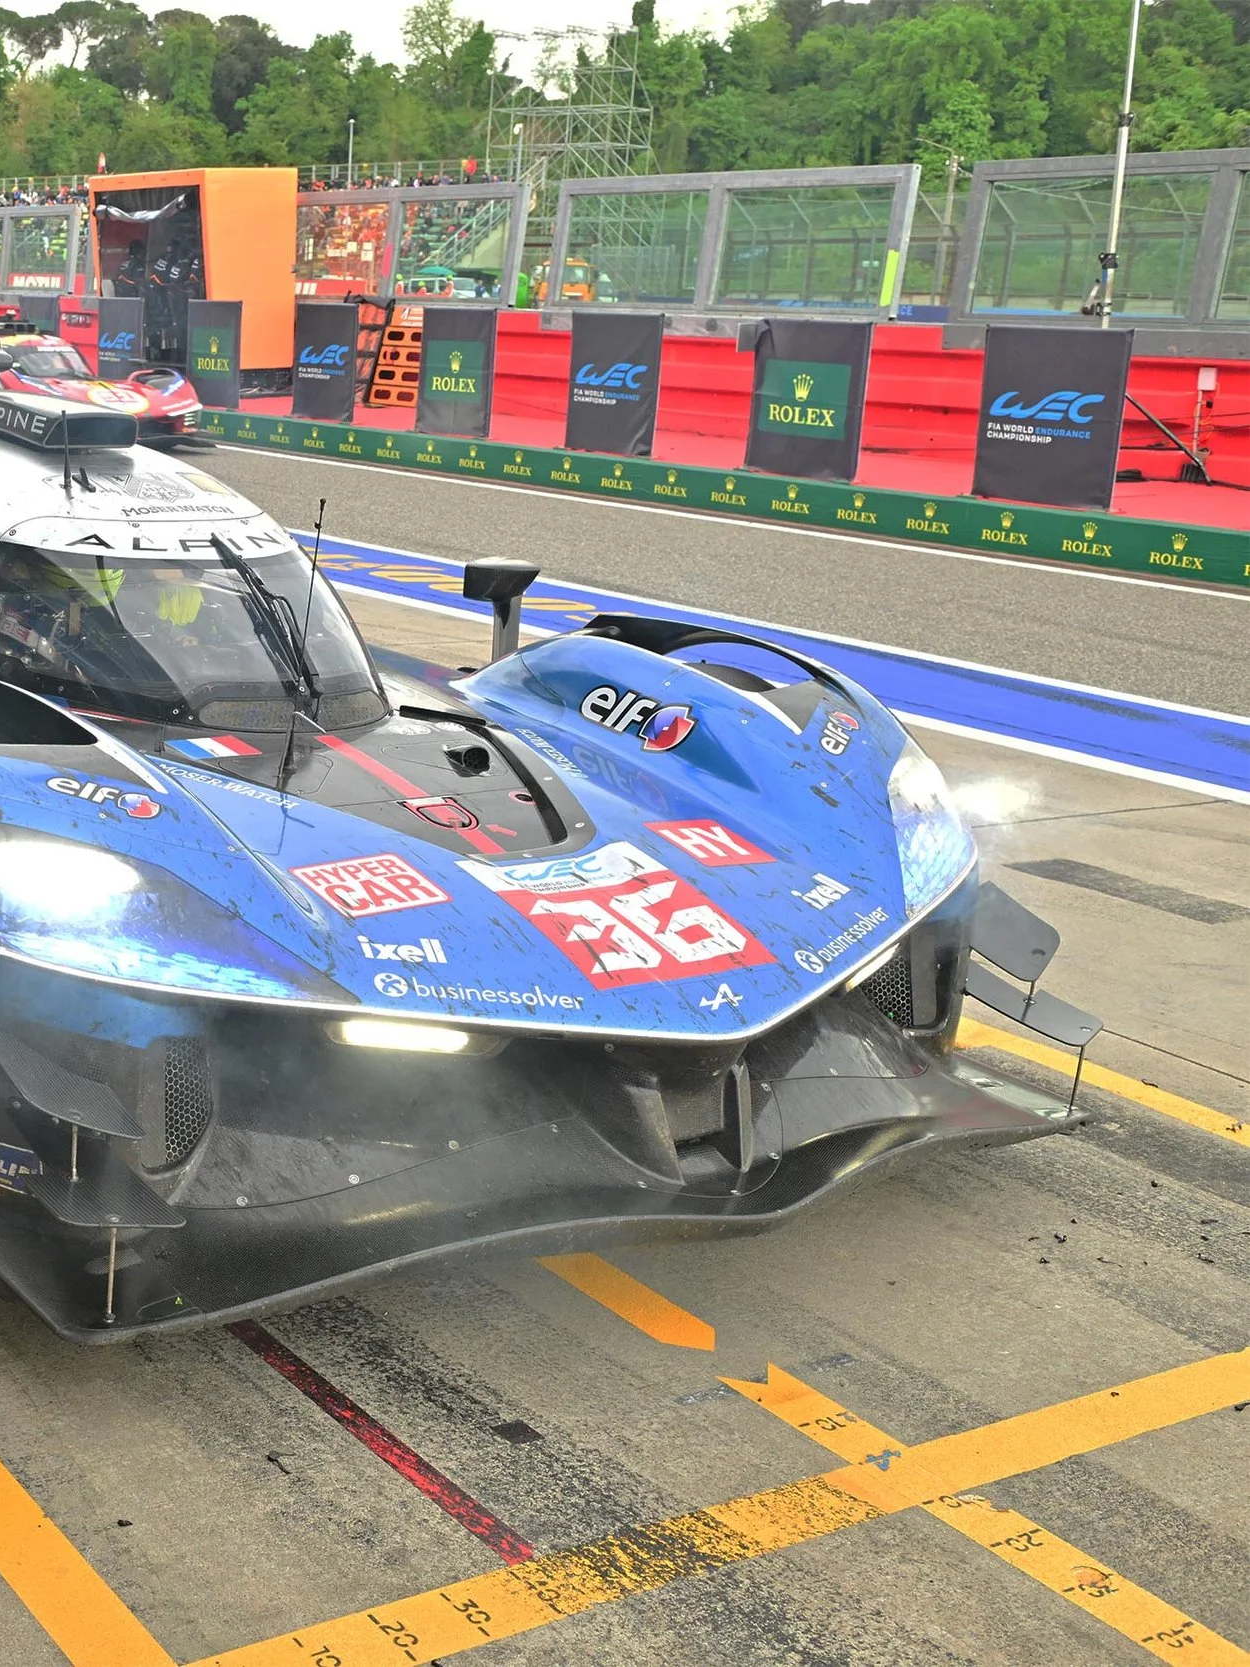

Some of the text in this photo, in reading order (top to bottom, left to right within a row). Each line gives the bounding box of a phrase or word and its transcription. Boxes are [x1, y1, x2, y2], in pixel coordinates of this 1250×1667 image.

[99, 332, 135, 350] WEC
[300, 344, 350, 366] WEC
[197, 358, 230, 371] ROLEX
[575, 363, 648, 389] WEC
[431, 376, 476, 395] ROLEX
[573, 395, 617, 405] CHAMPIONSHIP
[584, 389, 605, 397] WORLD
[605, 391, 640, 401] ENDURANCE
[768, 403, 835, 428] ROLEX
[990, 390, 1105, 424] WEC
[270, 434, 290, 444] ROLEX
[986, 430, 1052, 444] CHAMPIONSHIP
[987, 422, 1091, 439] FIA WORLD ENDURANCE
[303, 438, 325, 449] ROLEX
[339, 443, 361, 455] ROLEX
[377, 448, 400, 460] ROLEX
[417, 453, 442, 464] ROLEX
[459, 458, 486, 470] ROLEX
[503, 463, 531, 476] ROLEX
[551, 470, 581, 484] ROLEX
[601, 477, 632, 491] ROLEX
[654, 484, 687, 498] ROLEX
[711, 491, 746, 506] ROLEX
[771, 499, 810, 514] ROLEX
[837, 508, 877, 524] ROLEX
[906, 518, 949, 534] ROLEX
[65, 531, 285, 552] ALPIN
[981, 528, 1028, 546] ROLEX
[1062, 539, 1113, 557] ROLEX
[1150, 551, 1204, 570] ROLEX
[580, 686, 657, 733] elf
[819, 719, 853, 755] elf
[47, 777, 119, 804] elf
[159, 763, 299, 810] MOSER.WATCH
[658, 826, 750, 859] HY
[301, 858, 408, 887] HYPER
[504, 855, 602, 881] WEC
[324, 875, 440, 912] CAR
[790, 872, 851, 911] ixell
[529, 880, 747, 974] 36
[818, 906, 890, 962] businessolver
[357, 935, 448, 964] ixell
[413, 977, 585, 1010] businessolver
[453, 1598, 492, 1625] 30
[379, 1620, 419, 1649] 20
